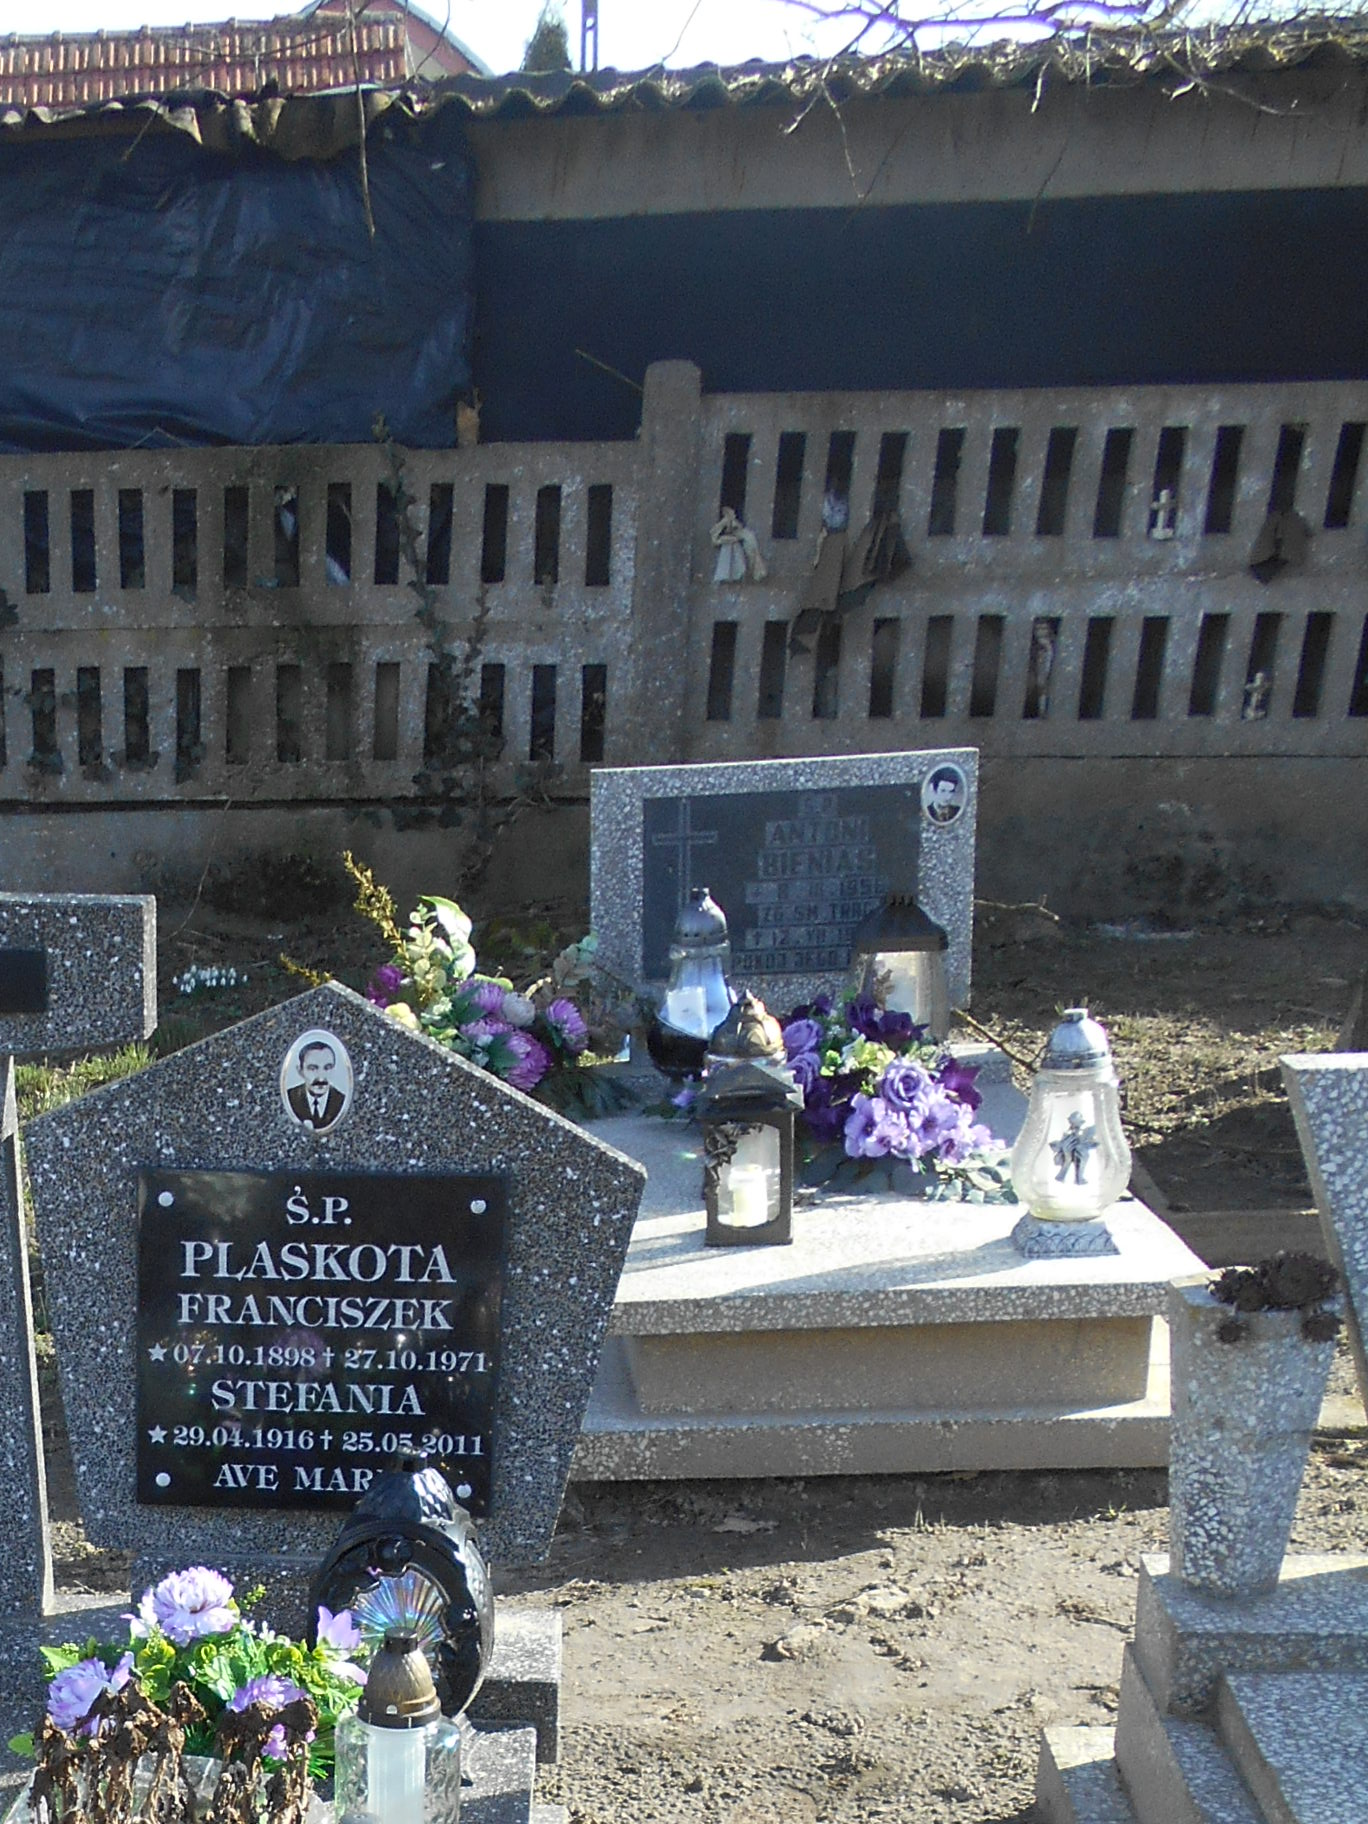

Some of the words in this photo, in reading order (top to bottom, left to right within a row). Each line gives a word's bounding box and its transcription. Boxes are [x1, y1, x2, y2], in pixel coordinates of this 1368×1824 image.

[285, 1185, 353, 1226] Ś.P.
[179, 1239, 457, 1284] PLASKOTA
[177, 1292, 455, 1331] FRANCISZEK
[173, 1344, 316, 1368] 07.10.1898
[343, 1348, 489, 1373] 27.10.1971
[210, 1378, 426, 1417] STEFANIA
[173, 1425, 314, 1451] 29.04.1916
[342, 1431, 484, 1456] 25.052011
[212, 1463, 280, 1491] AVE
[293, 1466, 383, 1493] MAR
